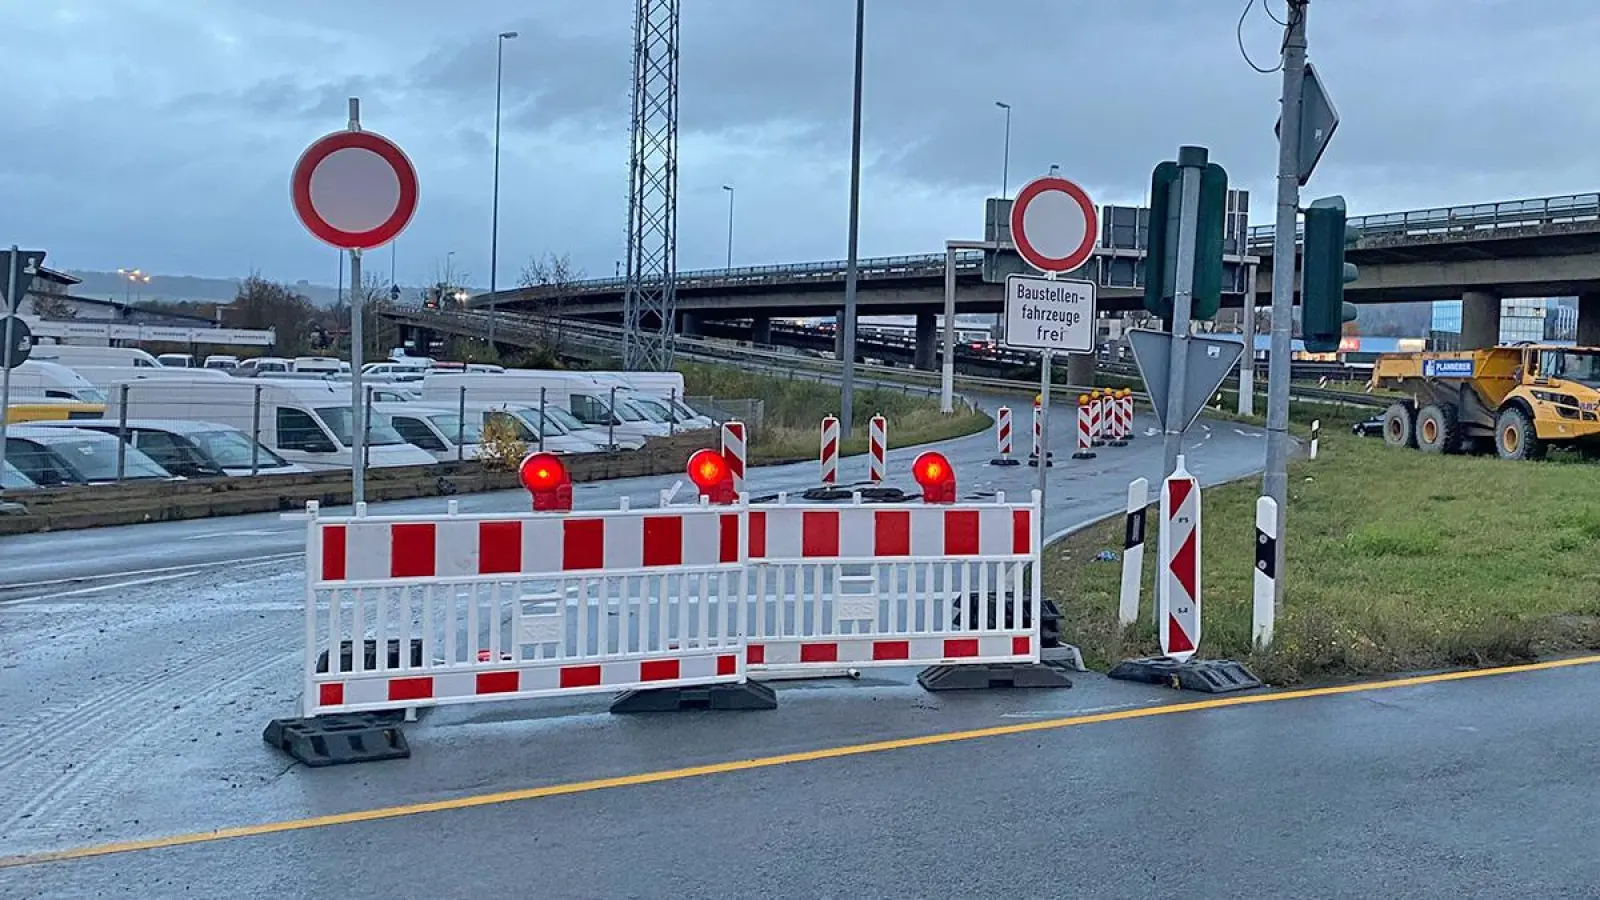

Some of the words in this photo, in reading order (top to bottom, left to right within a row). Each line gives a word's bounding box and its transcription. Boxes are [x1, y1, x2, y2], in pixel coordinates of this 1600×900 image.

[1017, 284, 1085, 303] Baustellen-
[1022, 304, 1080, 326] fahrzeuge
[1037, 326, 1064, 341] frei
